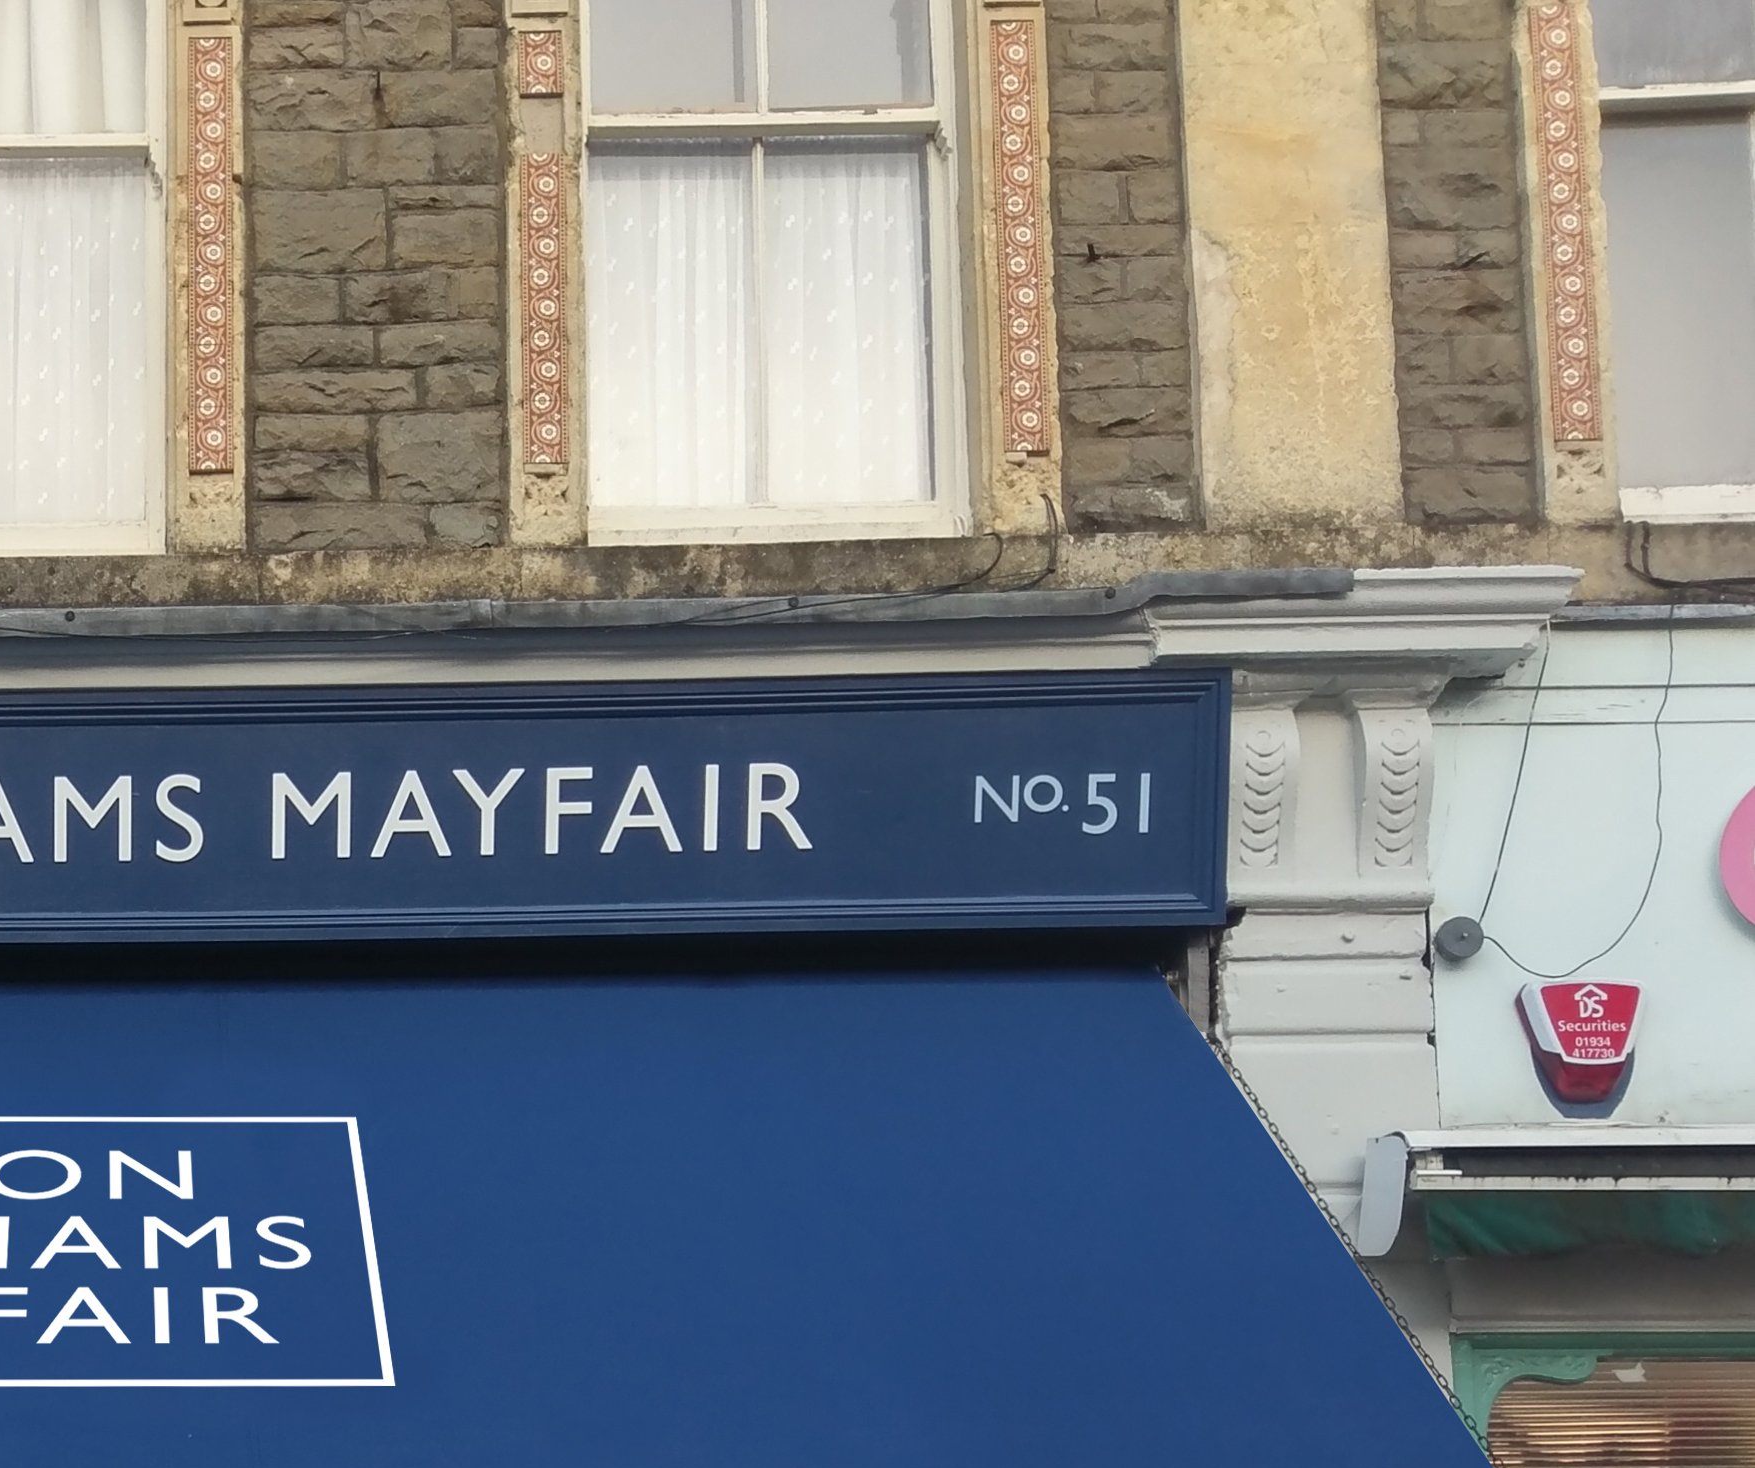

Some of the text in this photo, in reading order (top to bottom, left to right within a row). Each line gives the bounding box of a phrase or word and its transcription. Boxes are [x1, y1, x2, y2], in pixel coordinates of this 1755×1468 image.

[271, 762, 813, 859] MAYFAIR
[1579, 996, 1604, 1018] DS
[1558, 1020, 1627, 1032] Securities
[1575, 1036, 1611, 1047] 01934
[1571, 1048, 1616, 1058] 417730
